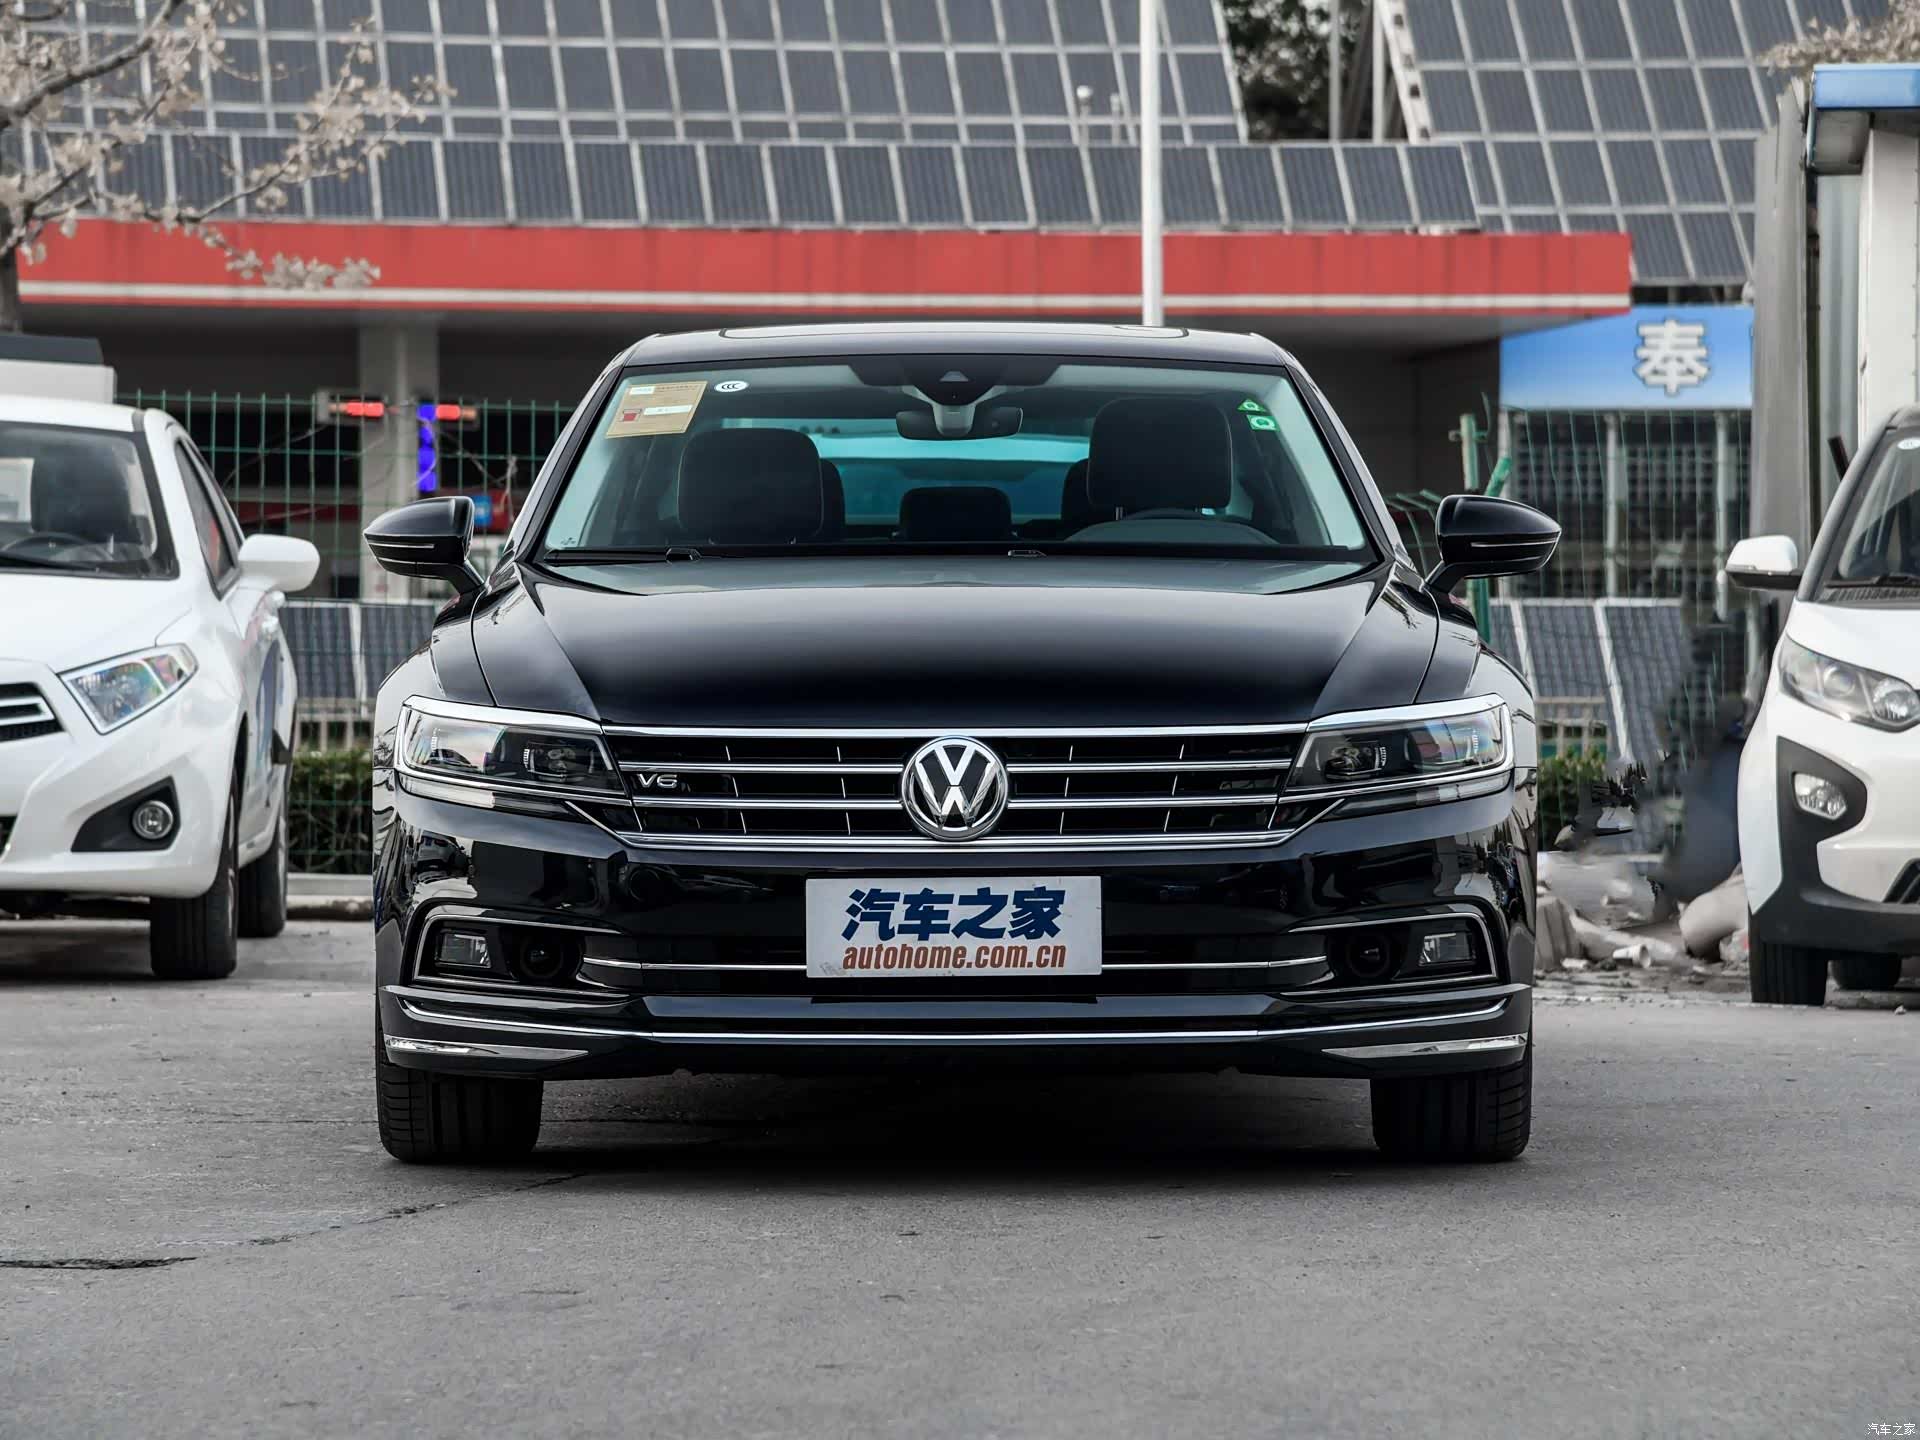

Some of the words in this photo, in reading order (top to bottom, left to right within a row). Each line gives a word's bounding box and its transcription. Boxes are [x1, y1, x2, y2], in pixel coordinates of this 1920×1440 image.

[637, 773, 678, 789] V6
[841, 886, 1066, 941] 汽车之家
[842, 943, 1066, 970] autohome.com.cn
